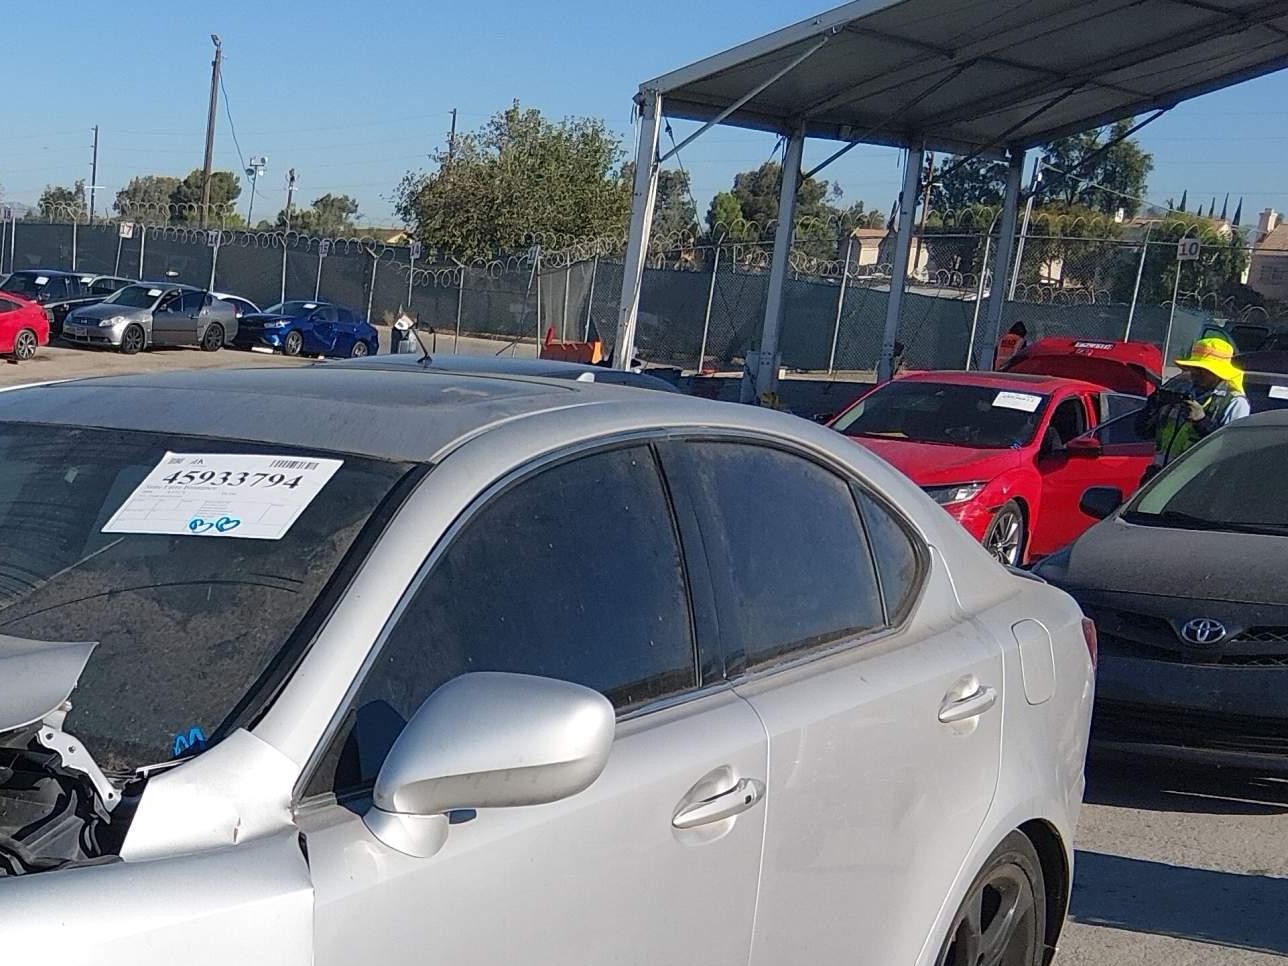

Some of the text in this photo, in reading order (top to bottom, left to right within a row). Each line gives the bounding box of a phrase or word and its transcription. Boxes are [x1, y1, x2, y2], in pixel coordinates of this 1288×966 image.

[120, 224, 132, 235] 17
[1178, 241, 1199, 256] 10
[163, 470, 304, 489] 45933794
